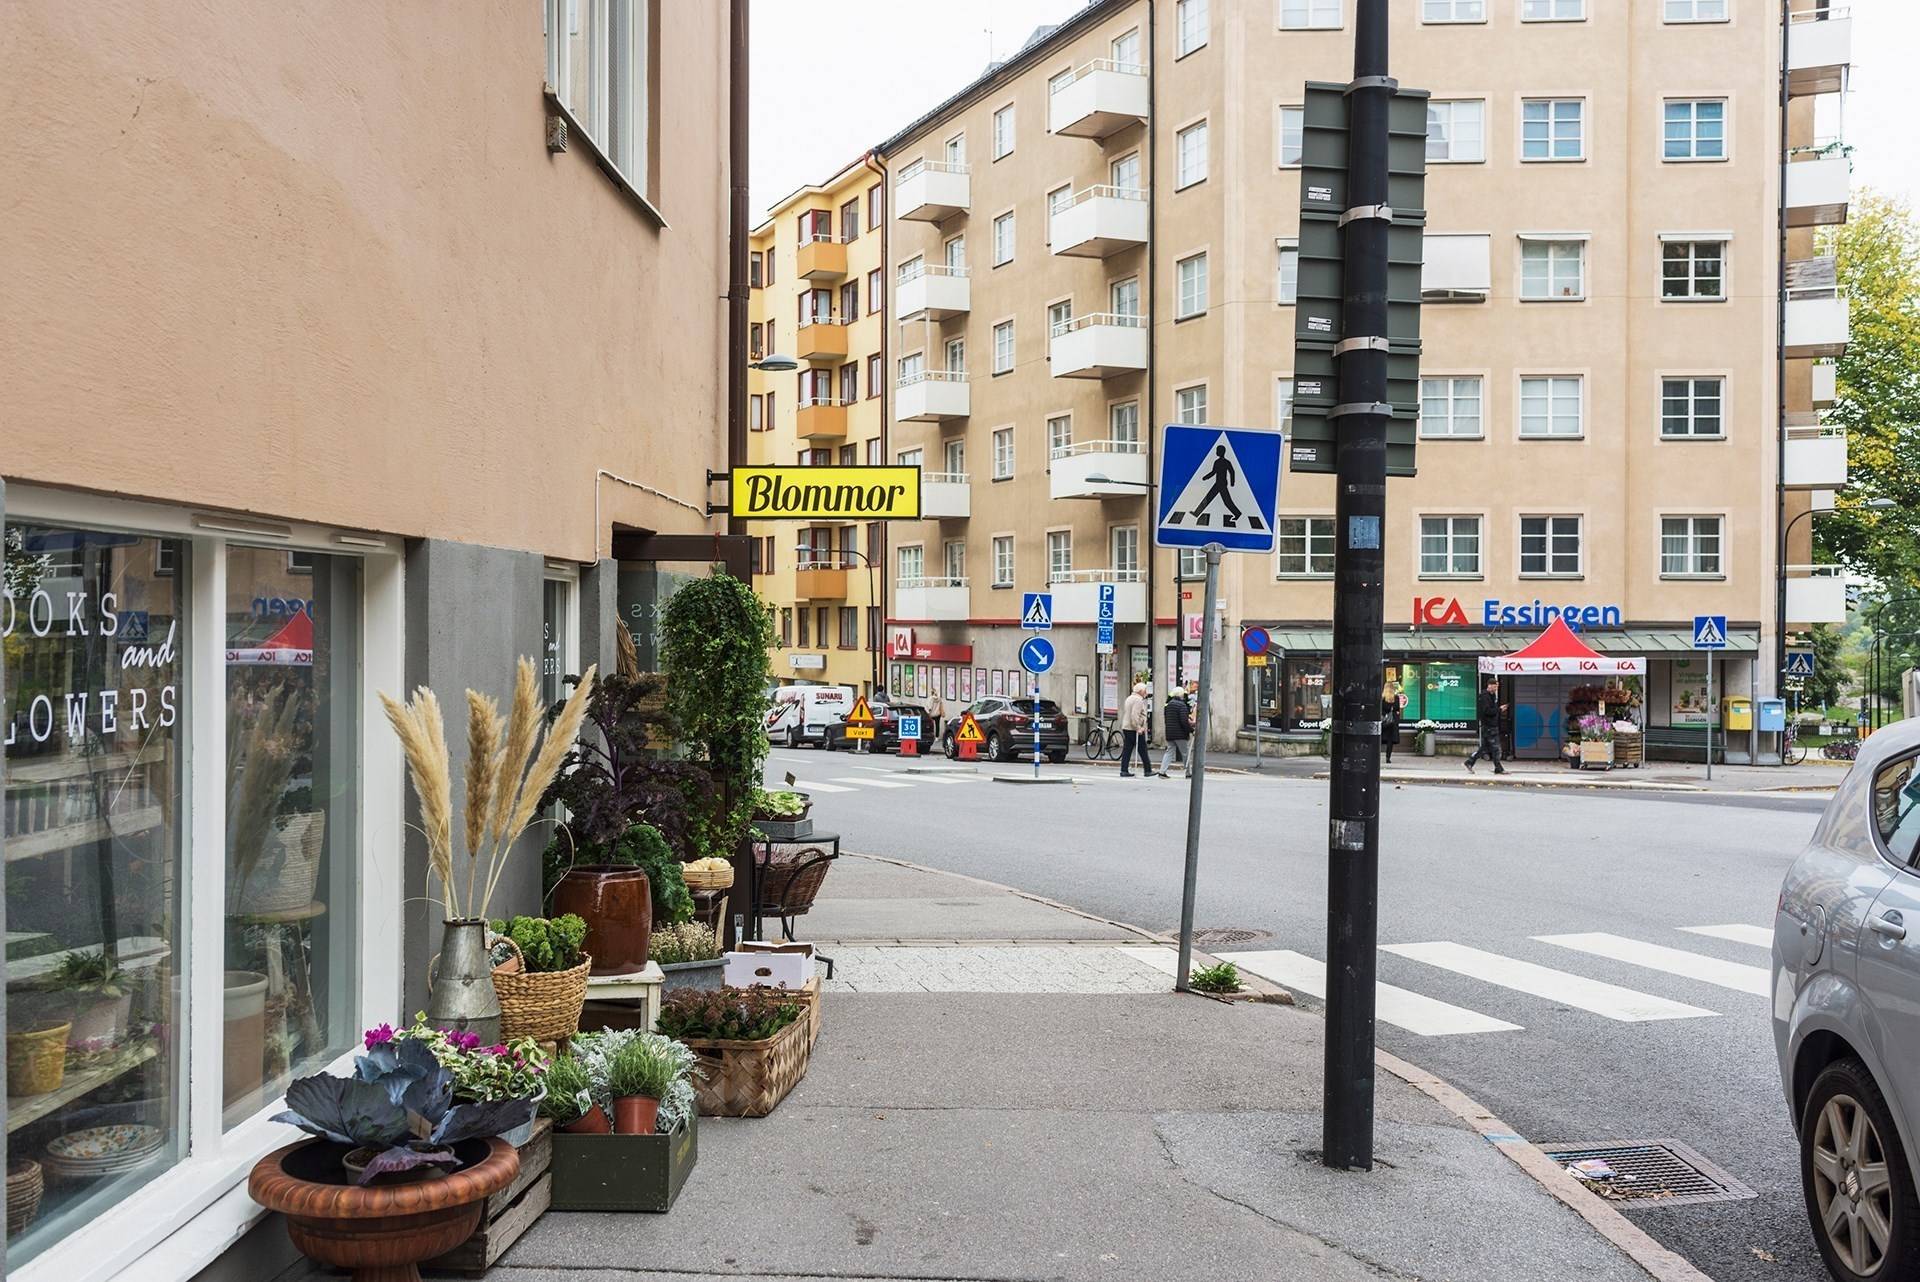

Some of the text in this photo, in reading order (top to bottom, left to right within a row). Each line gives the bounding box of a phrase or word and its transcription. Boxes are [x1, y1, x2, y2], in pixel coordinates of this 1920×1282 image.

[746, 475, 905, 511] Blommor
[1103, 586, 1112, 600] P
[1413, 597, 1621, 633] ICA Essingen
[121, 620, 176, 669] and
[895, 633, 909, 651] ICA
[1504, 662, 1524, 671] ICA
[1541, 661, 1561, 671] ICA
[1579, 660, 1599, 670] ICA
[1616, 659, 1636, 670] ICA
[904, 723, 916, 732] 30
[1298, 720, 1319, 729] Öppet
